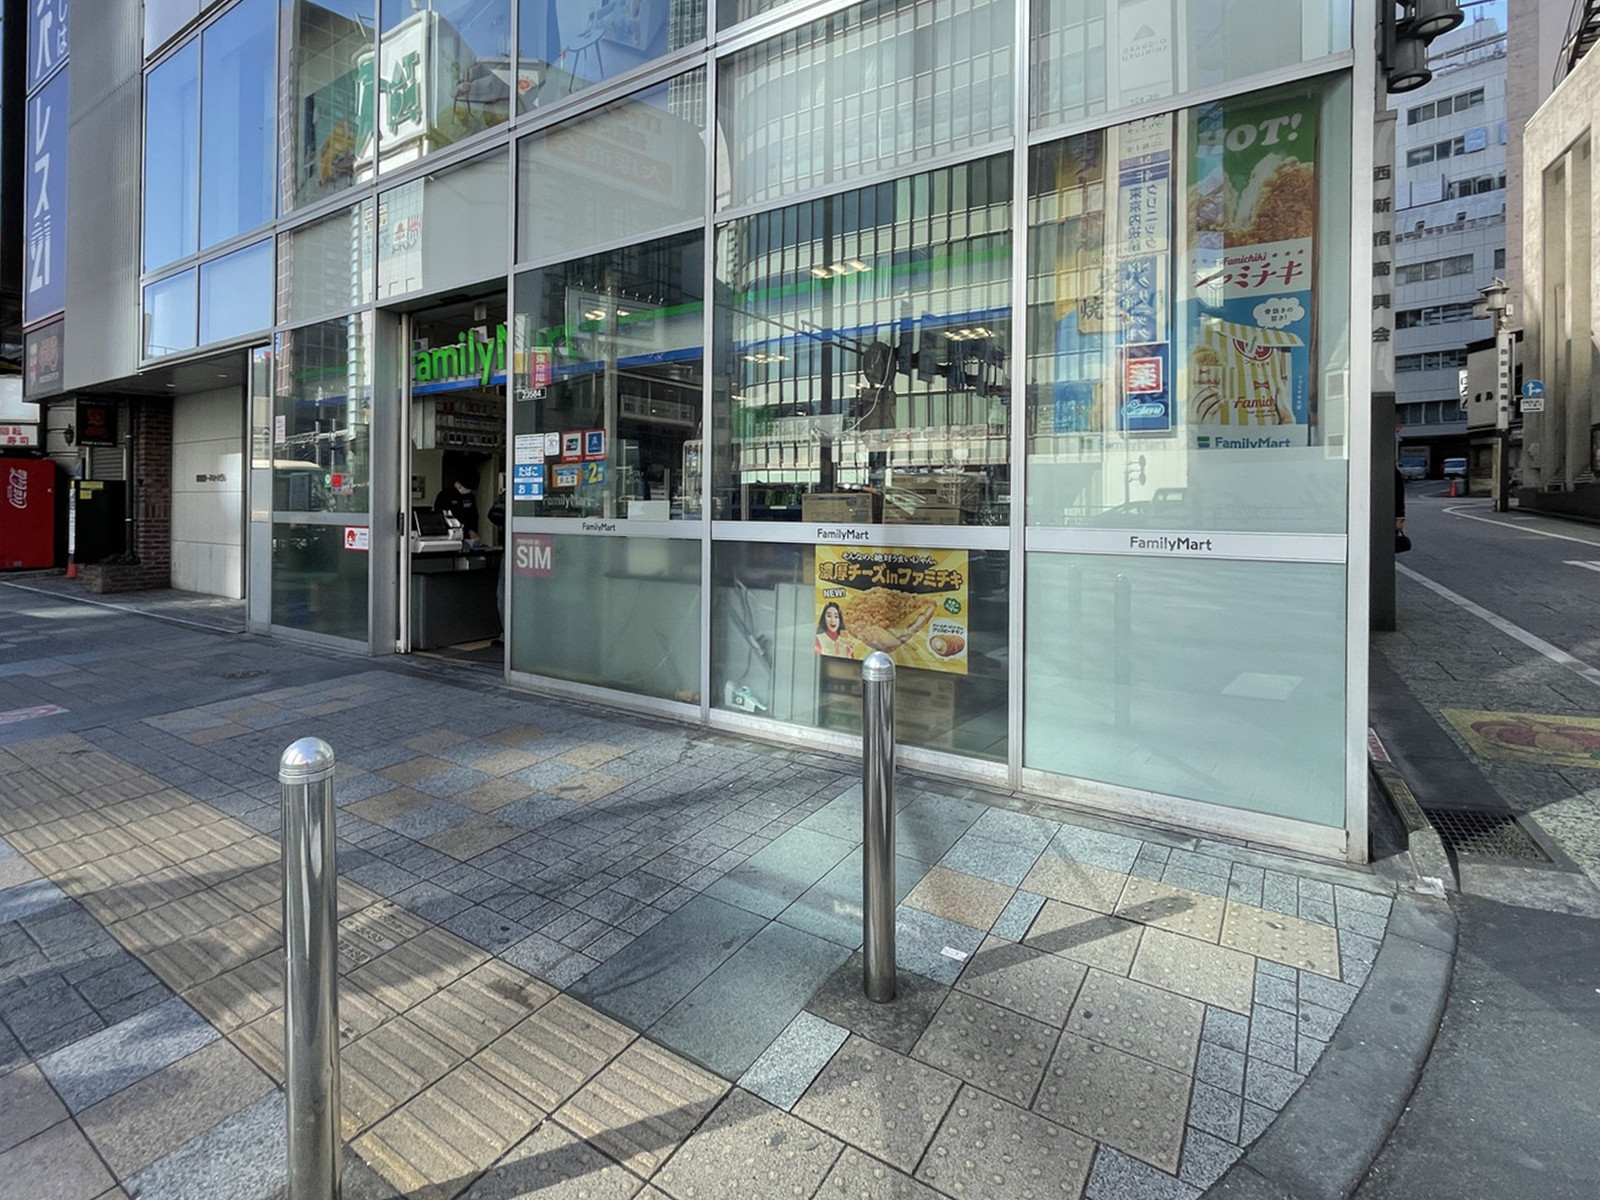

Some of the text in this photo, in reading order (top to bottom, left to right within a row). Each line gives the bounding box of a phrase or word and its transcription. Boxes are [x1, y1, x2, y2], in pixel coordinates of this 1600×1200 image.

[1372, 164, 1391, 343] 西新宿商興会
[1215, 436, 1291, 449] FamilyMart
[518, 466, 539, 477] たばこ
[582, 522, 616, 532] FamilyMart
[817, 528, 869, 540] FamilyMart
[1130, 536, 1212, 551] FamilyMart
[517, 546, 551, 570] SIM
[818, 562, 963, 590] 濃厚チーズinファミチキ
[823, 588, 846, 598] NEW!
